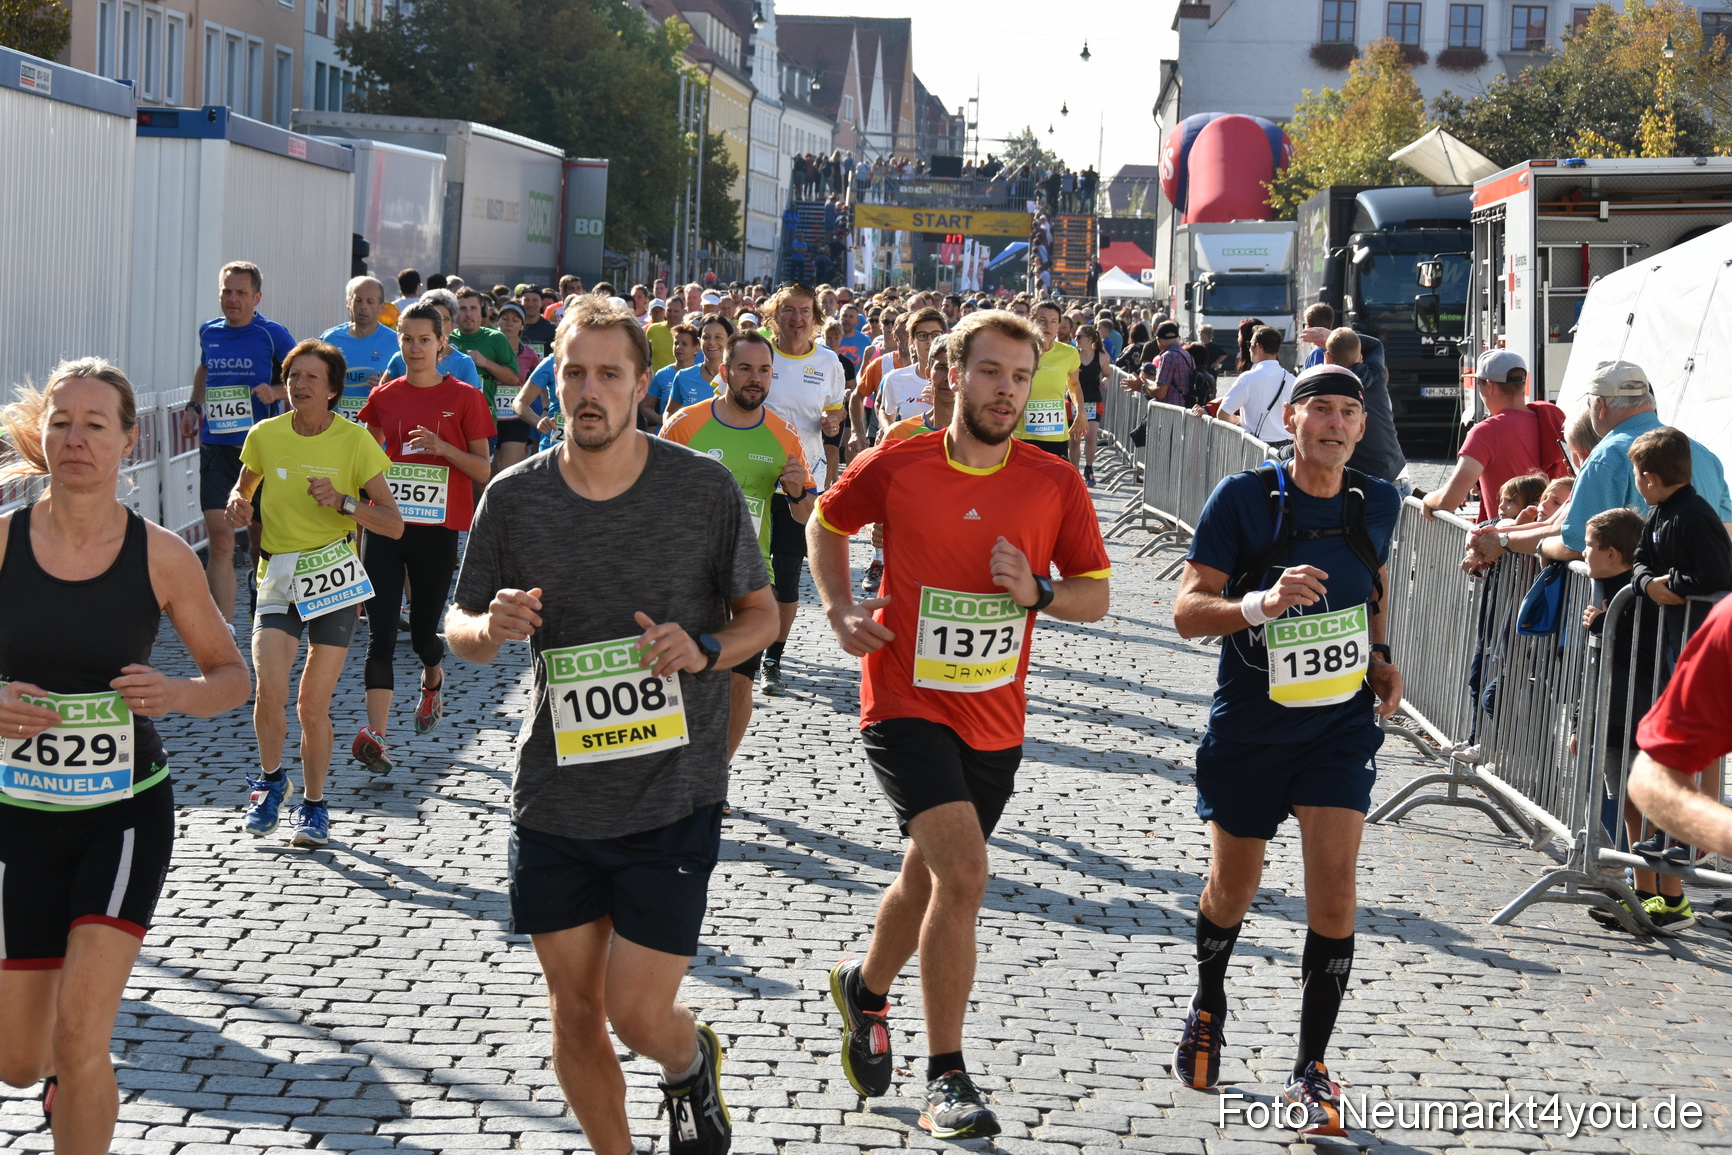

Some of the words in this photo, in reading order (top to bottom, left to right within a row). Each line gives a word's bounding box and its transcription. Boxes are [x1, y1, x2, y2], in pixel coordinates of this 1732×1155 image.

[912, 212, 974, 230] START
[1222, 248, 1269, 256] BOCK
[207, 358, 253, 369] SYSCAD
[208, 387, 246, 400] BOCK
[209, 402, 246, 418] 2146
[1027, 401, 1061, 410] BOCK
[1029, 412, 1060, 424] 2211
[749, 453, 774, 463] BOCK
[388, 465, 443, 481] BOCK
[389, 482, 439, 503] 2567
[296, 542, 351, 573] BOCK
[300, 560, 355, 598] 2207
[307, 585, 364, 611] GABRIELE
[929, 592, 1021, 620] BOCK
[1273, 610, 1361, 645] BOCK
[932, 625, 1014, 658] 1373
[1282, 640, 1360, 678] 1389
[943, 662, 1008, 680] JANNIK
[563, 676, 667, 723] 1008
[581, 723, 657, 749] STEFAN
[11, 733, 117, 767] 2629
[13, 771, 115, 793] MANUELA
